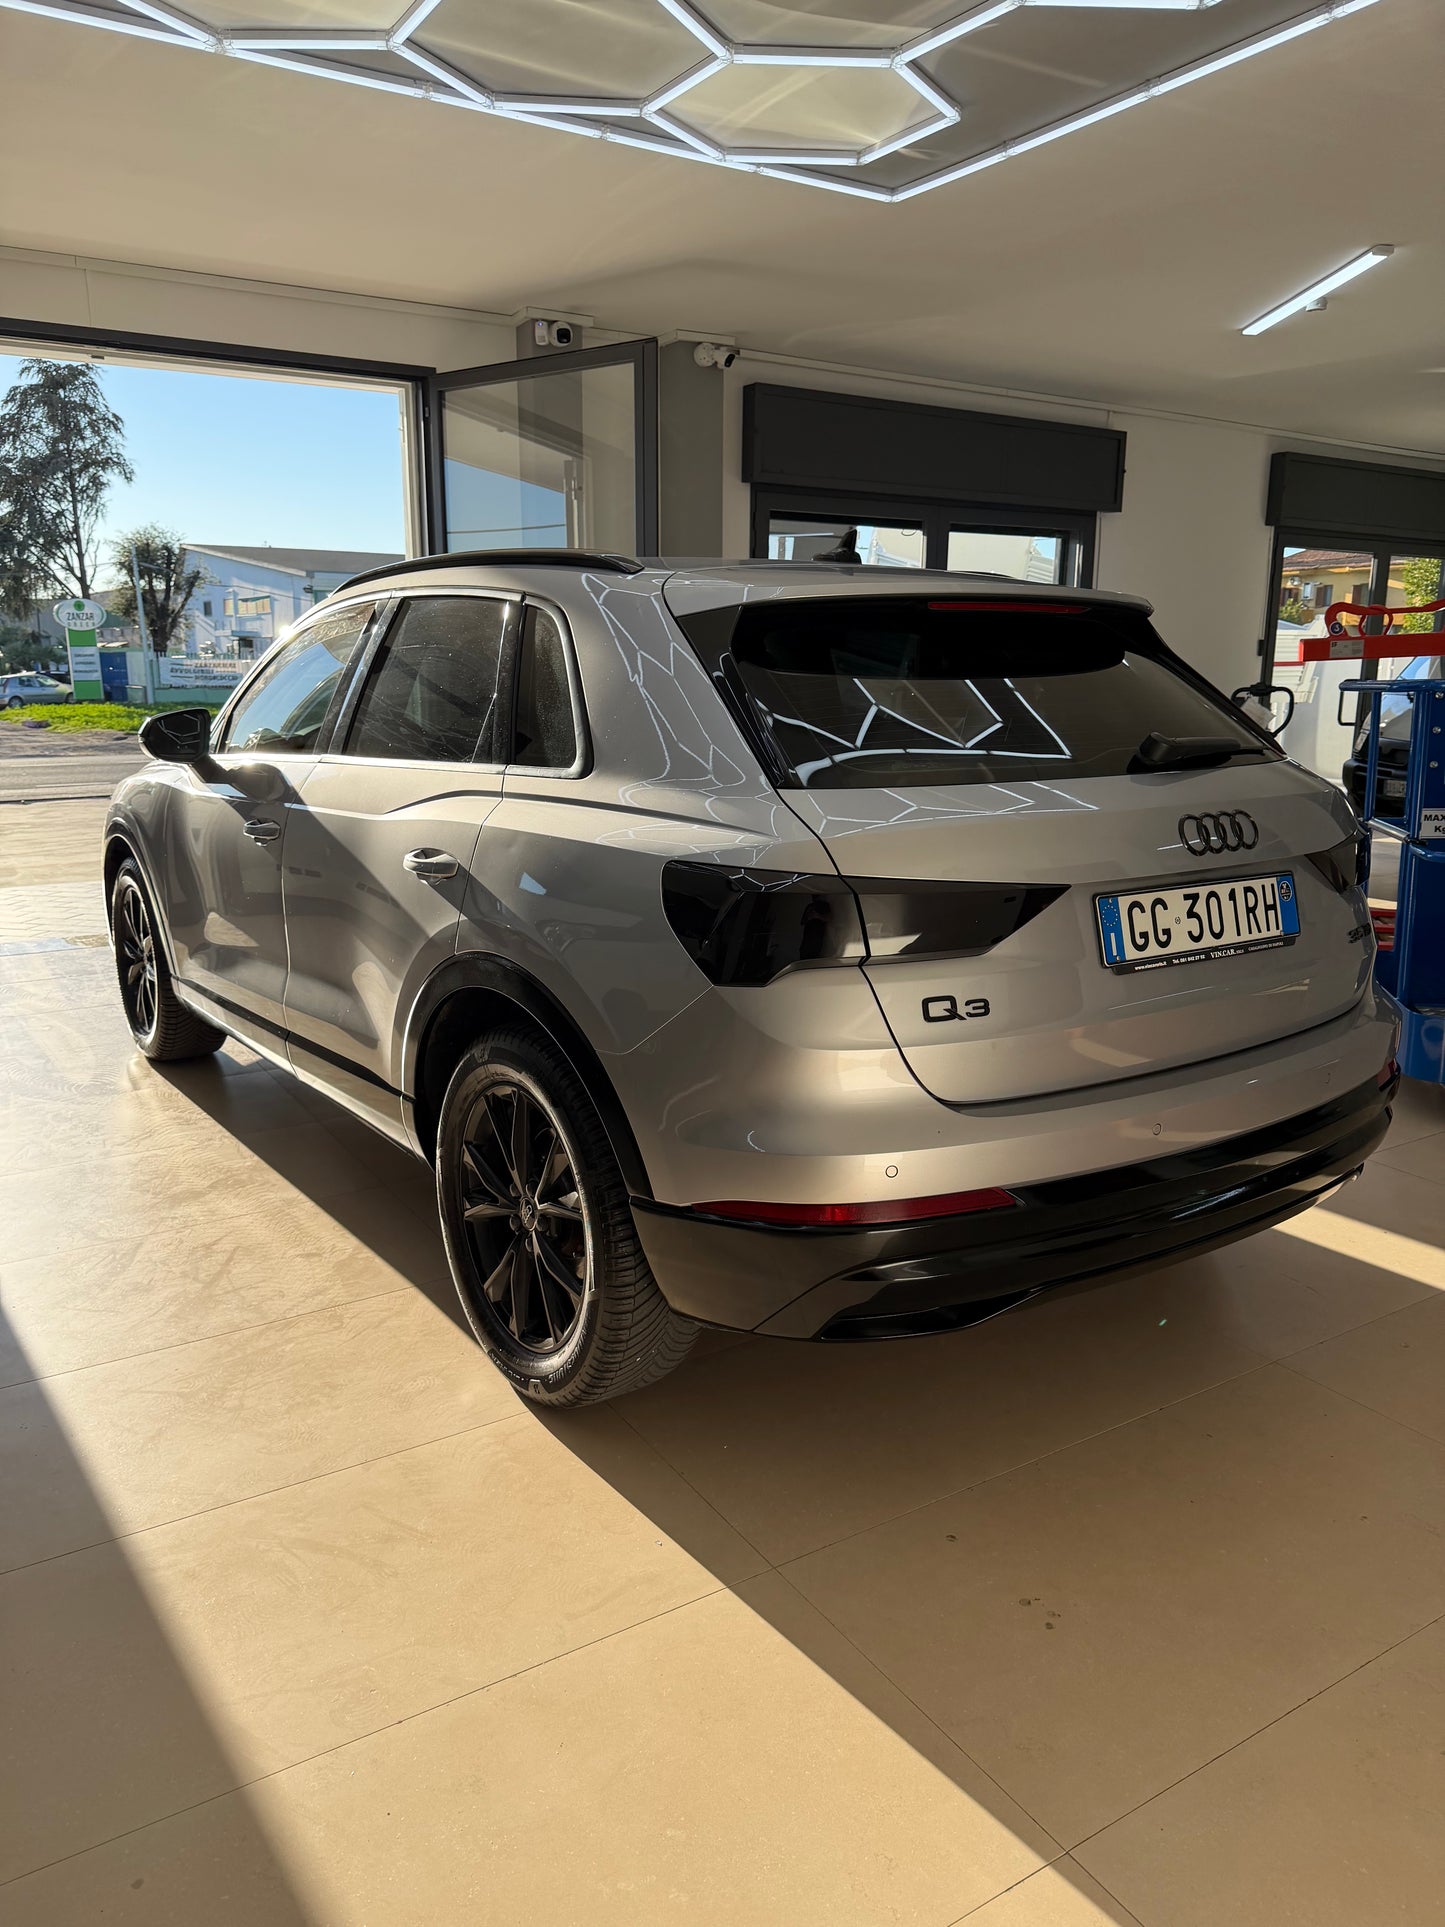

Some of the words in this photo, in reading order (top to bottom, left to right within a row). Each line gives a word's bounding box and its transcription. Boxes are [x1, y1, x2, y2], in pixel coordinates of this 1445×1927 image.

[66, 612, 95, 621] ZANZAR
[1127, 897, 1172, 953] GG
[922, 995, 990, 1023] Q3
